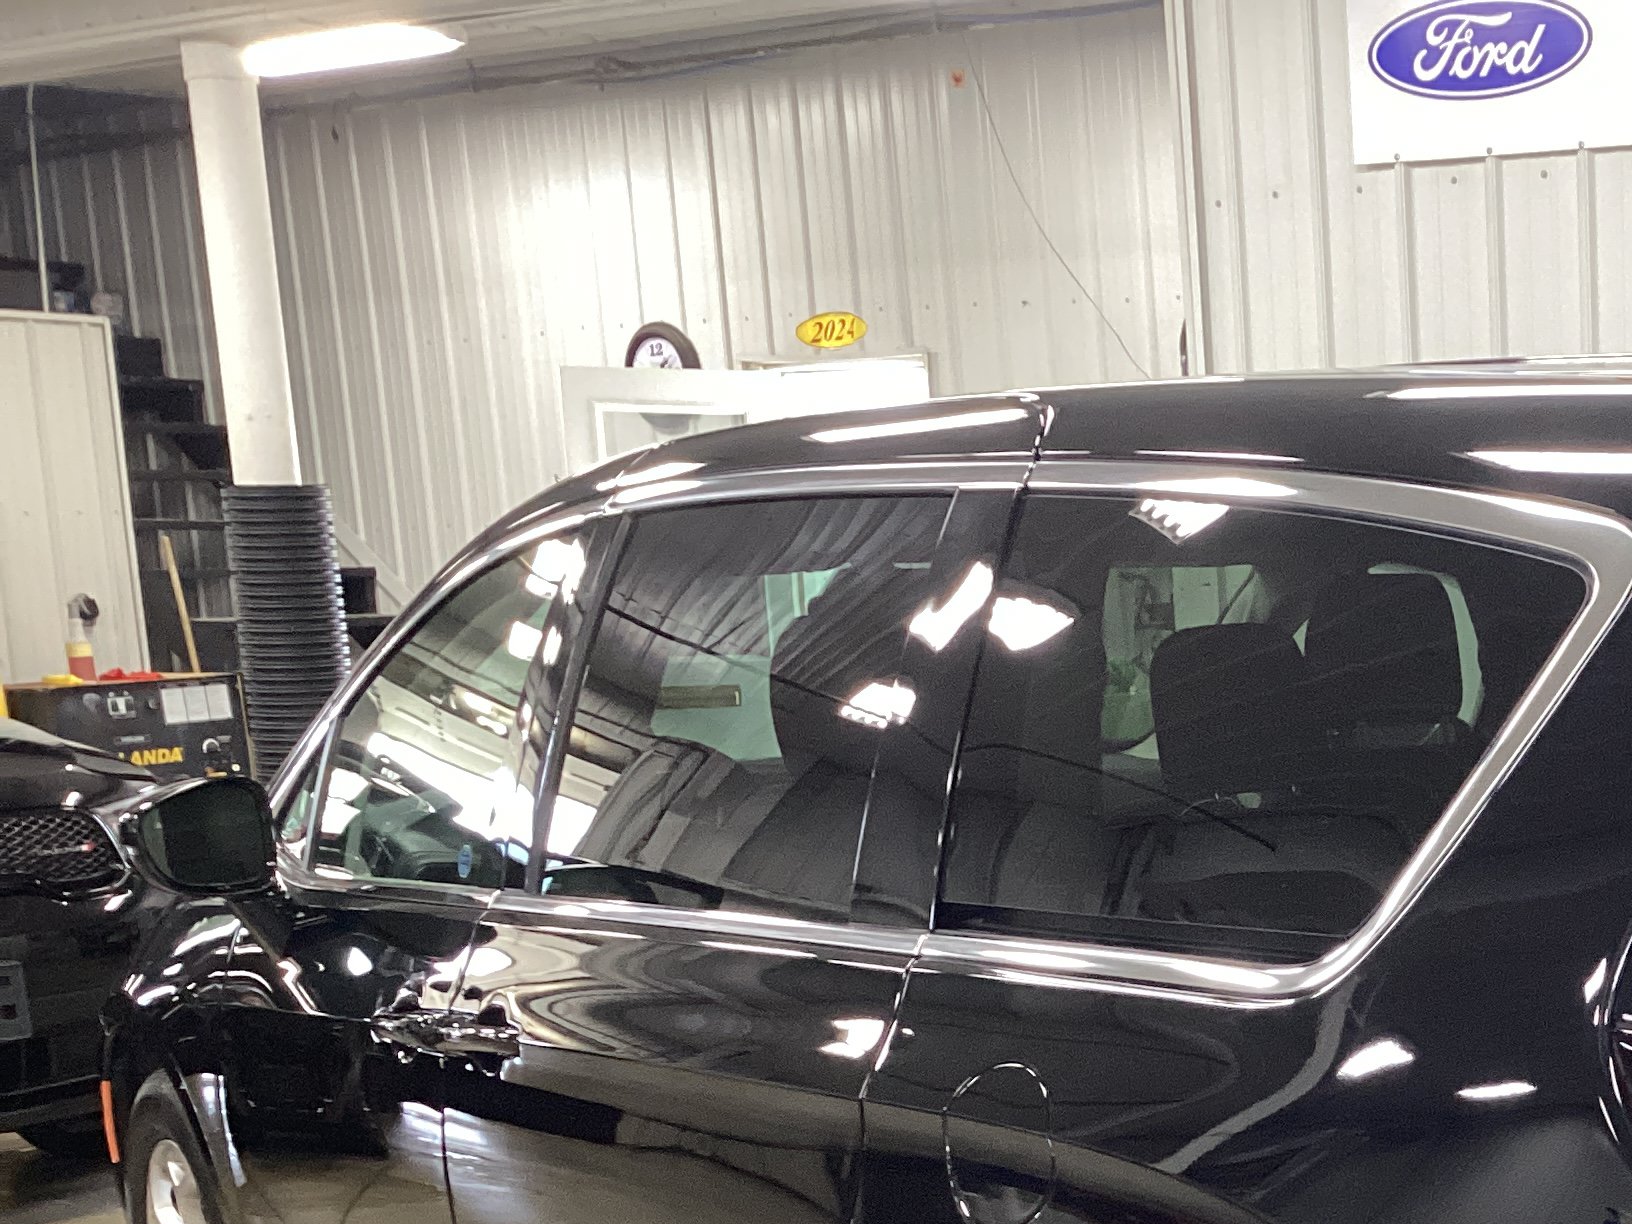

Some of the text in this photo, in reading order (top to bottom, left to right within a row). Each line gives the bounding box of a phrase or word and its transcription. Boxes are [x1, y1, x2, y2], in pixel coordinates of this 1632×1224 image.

[1413, 11, 1547, 82] Ford
[810, 317, 856, 343] 2024
[649, 342, 664, 357] 12
[118, 747, 183, 767] ANDA
